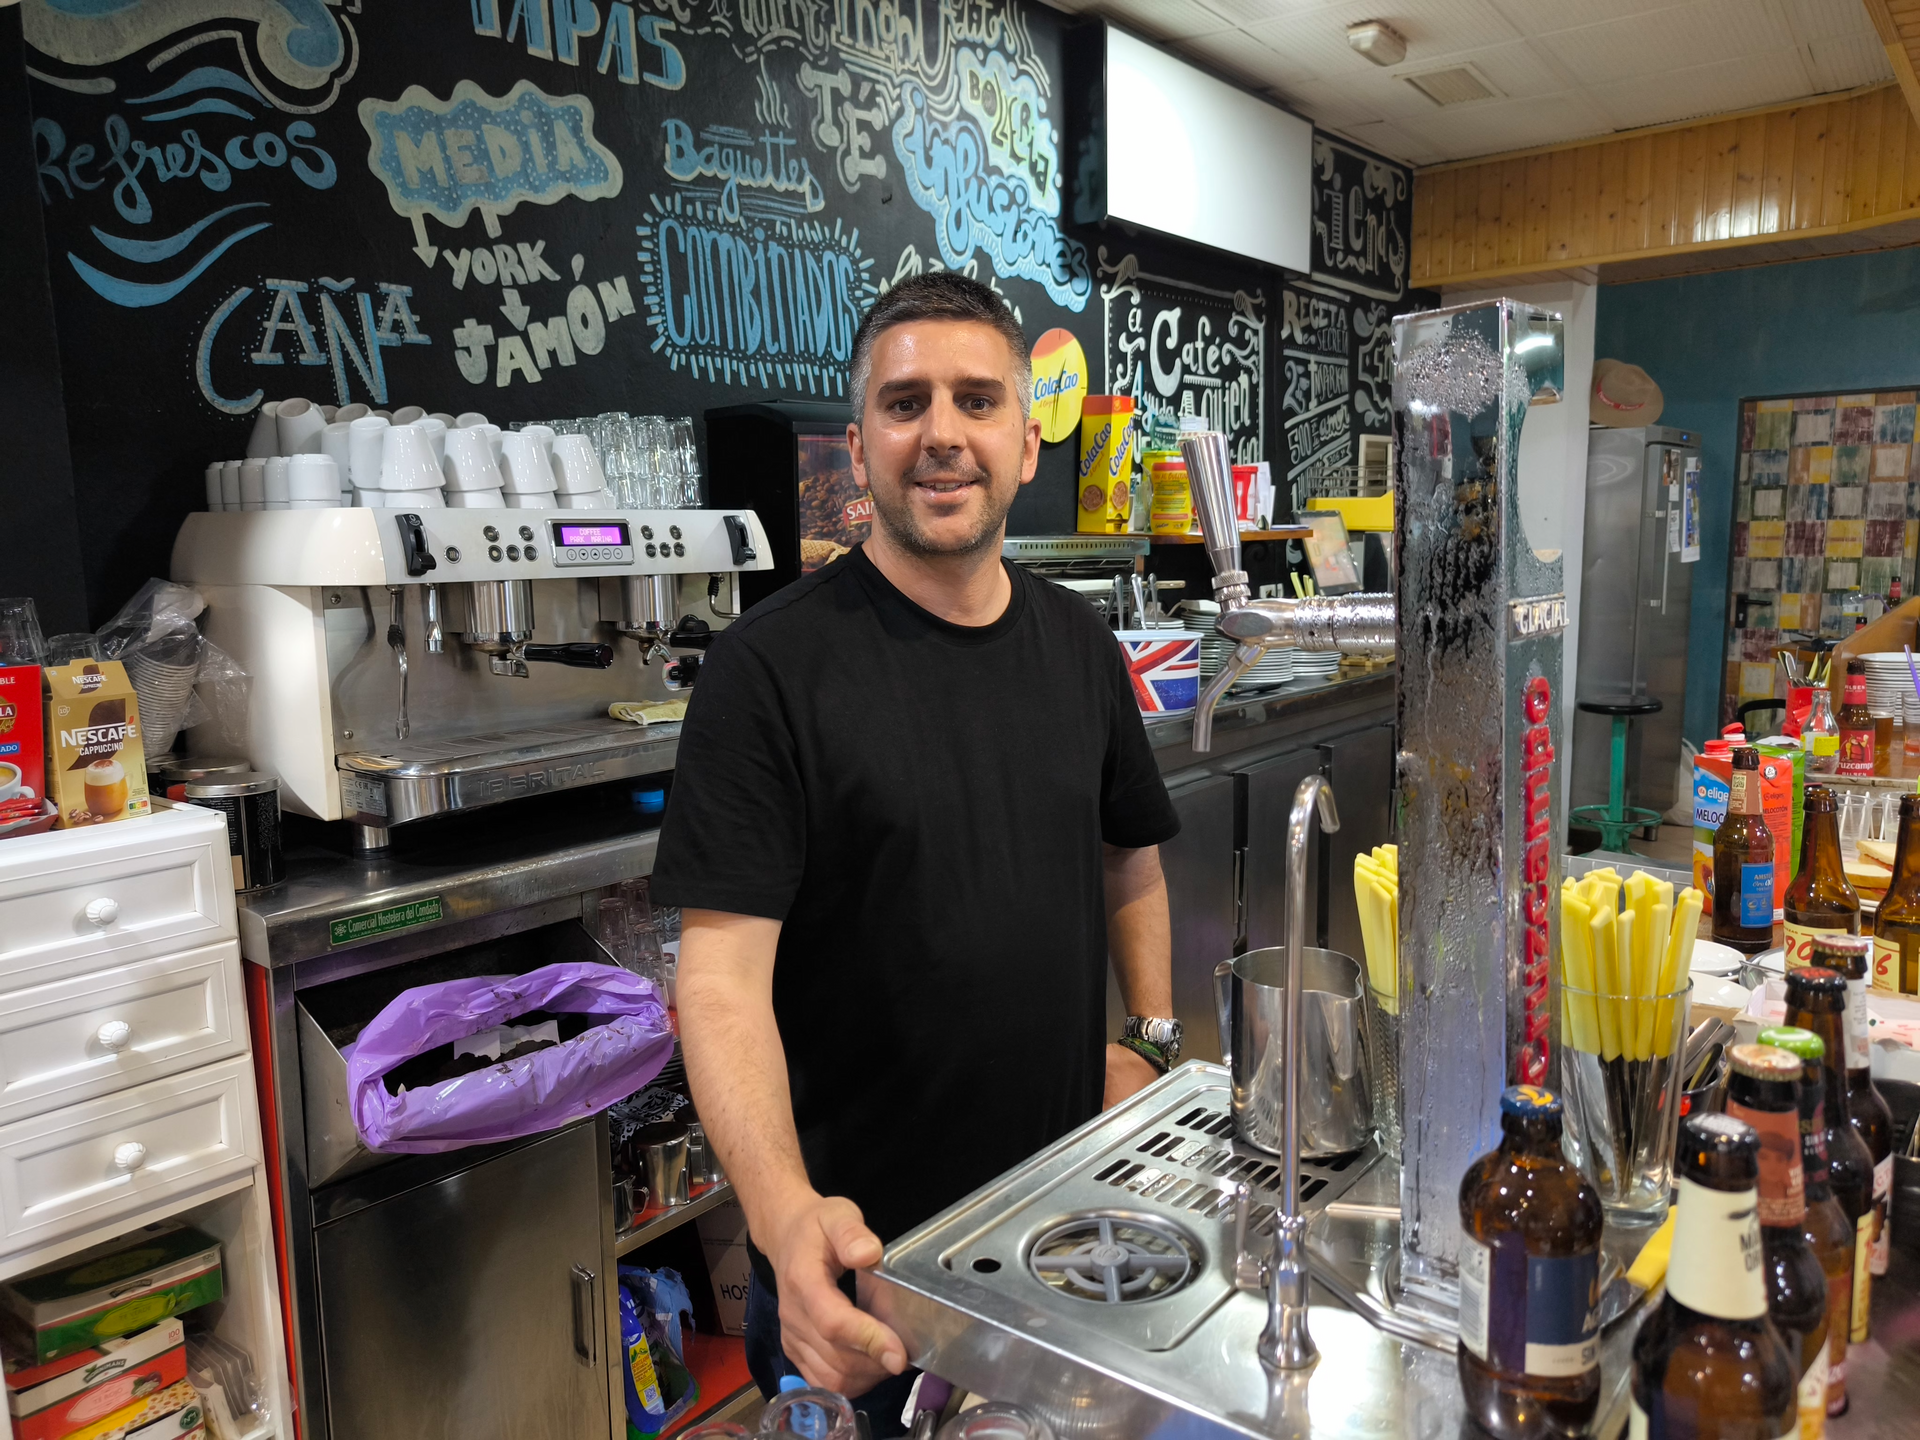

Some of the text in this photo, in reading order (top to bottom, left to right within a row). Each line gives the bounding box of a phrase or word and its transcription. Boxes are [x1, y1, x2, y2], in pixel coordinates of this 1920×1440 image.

[470, 0, 687, 90] TAPAS
[33, 113, 338, 224] Refrescos
[663, 119, 825, 224] Baguettes
[442, 240, 561, 290] YORK
[1281, 290, 1348, 345] RECETA
[195, 276, 432, 415] CAÑA
[1150, 306, 1221, 397] Café
[1079, 422, 1112, 478] ColaCao
[580, 528, 601, 536] COFFEE
[590, 535, 613, 543] MARINA
[1520, 600, 1570, 635] GLACIAL
[0, 677, 16, 685] BLE
[72, 672, 107, 684] NESCAFÉ
[60, 716, 137, 748] NESCAFÉ
[0, 744, 18, 753] ADO
[79, 742, 124, 756] CAPPUCCINO
[478, 762, 605, 796] IBERITAL
[1707, 786, 1729, 803] elige
[1695, 808, 1728, 827] MELOC
[348, 914, 377, 934] Comercial
[378, 909, 405, 926] Hostelera
[405, 905, 415, 918] del
[720, 1283, 748, 1301] HOS
[168, 1329, 180, 1339] 100
